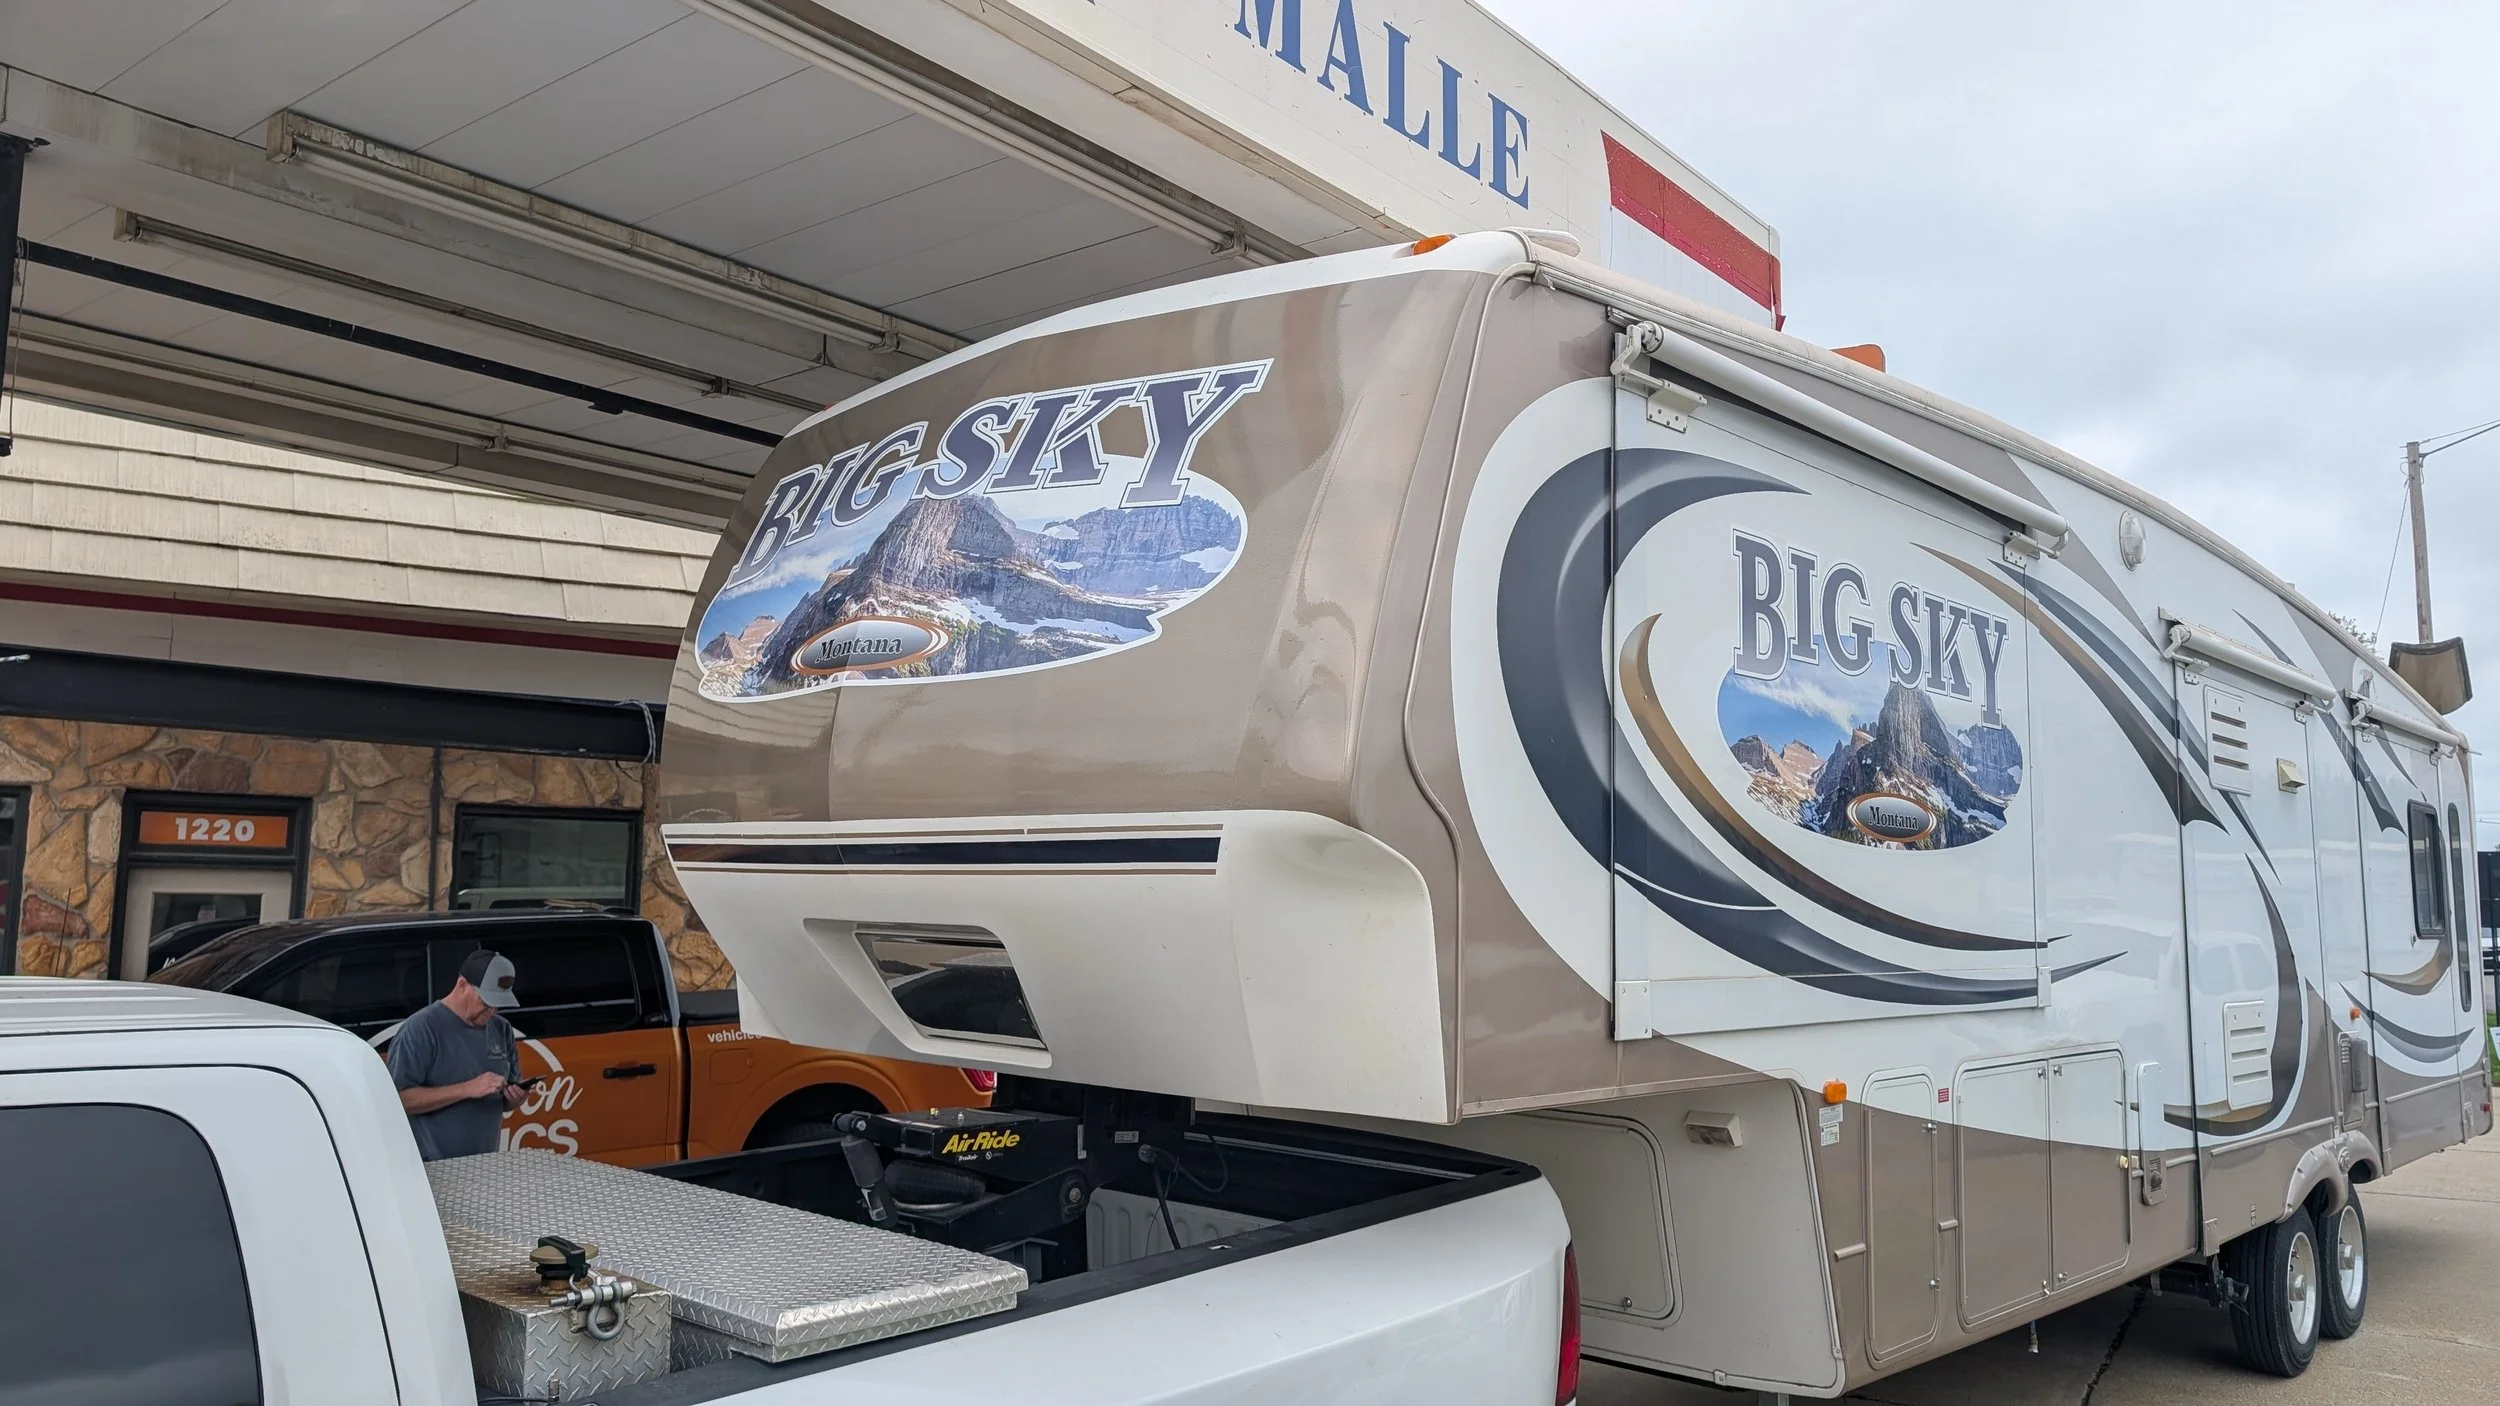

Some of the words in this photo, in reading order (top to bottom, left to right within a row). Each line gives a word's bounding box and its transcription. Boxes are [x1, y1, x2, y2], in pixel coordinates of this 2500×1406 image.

[1234, 0, 1529, 210] MALLE
[727, 421, 928, 590] BIG
[913, 358, 1274, 509] SKY
[814, 637, 903, 663] Montana
[1732, 527, 1875, 681] BIG
[1887, 581, 2010, 730] SKY
[175, 817, 255, 842] 1220
[1868, 806, 1918, 830] Montana
